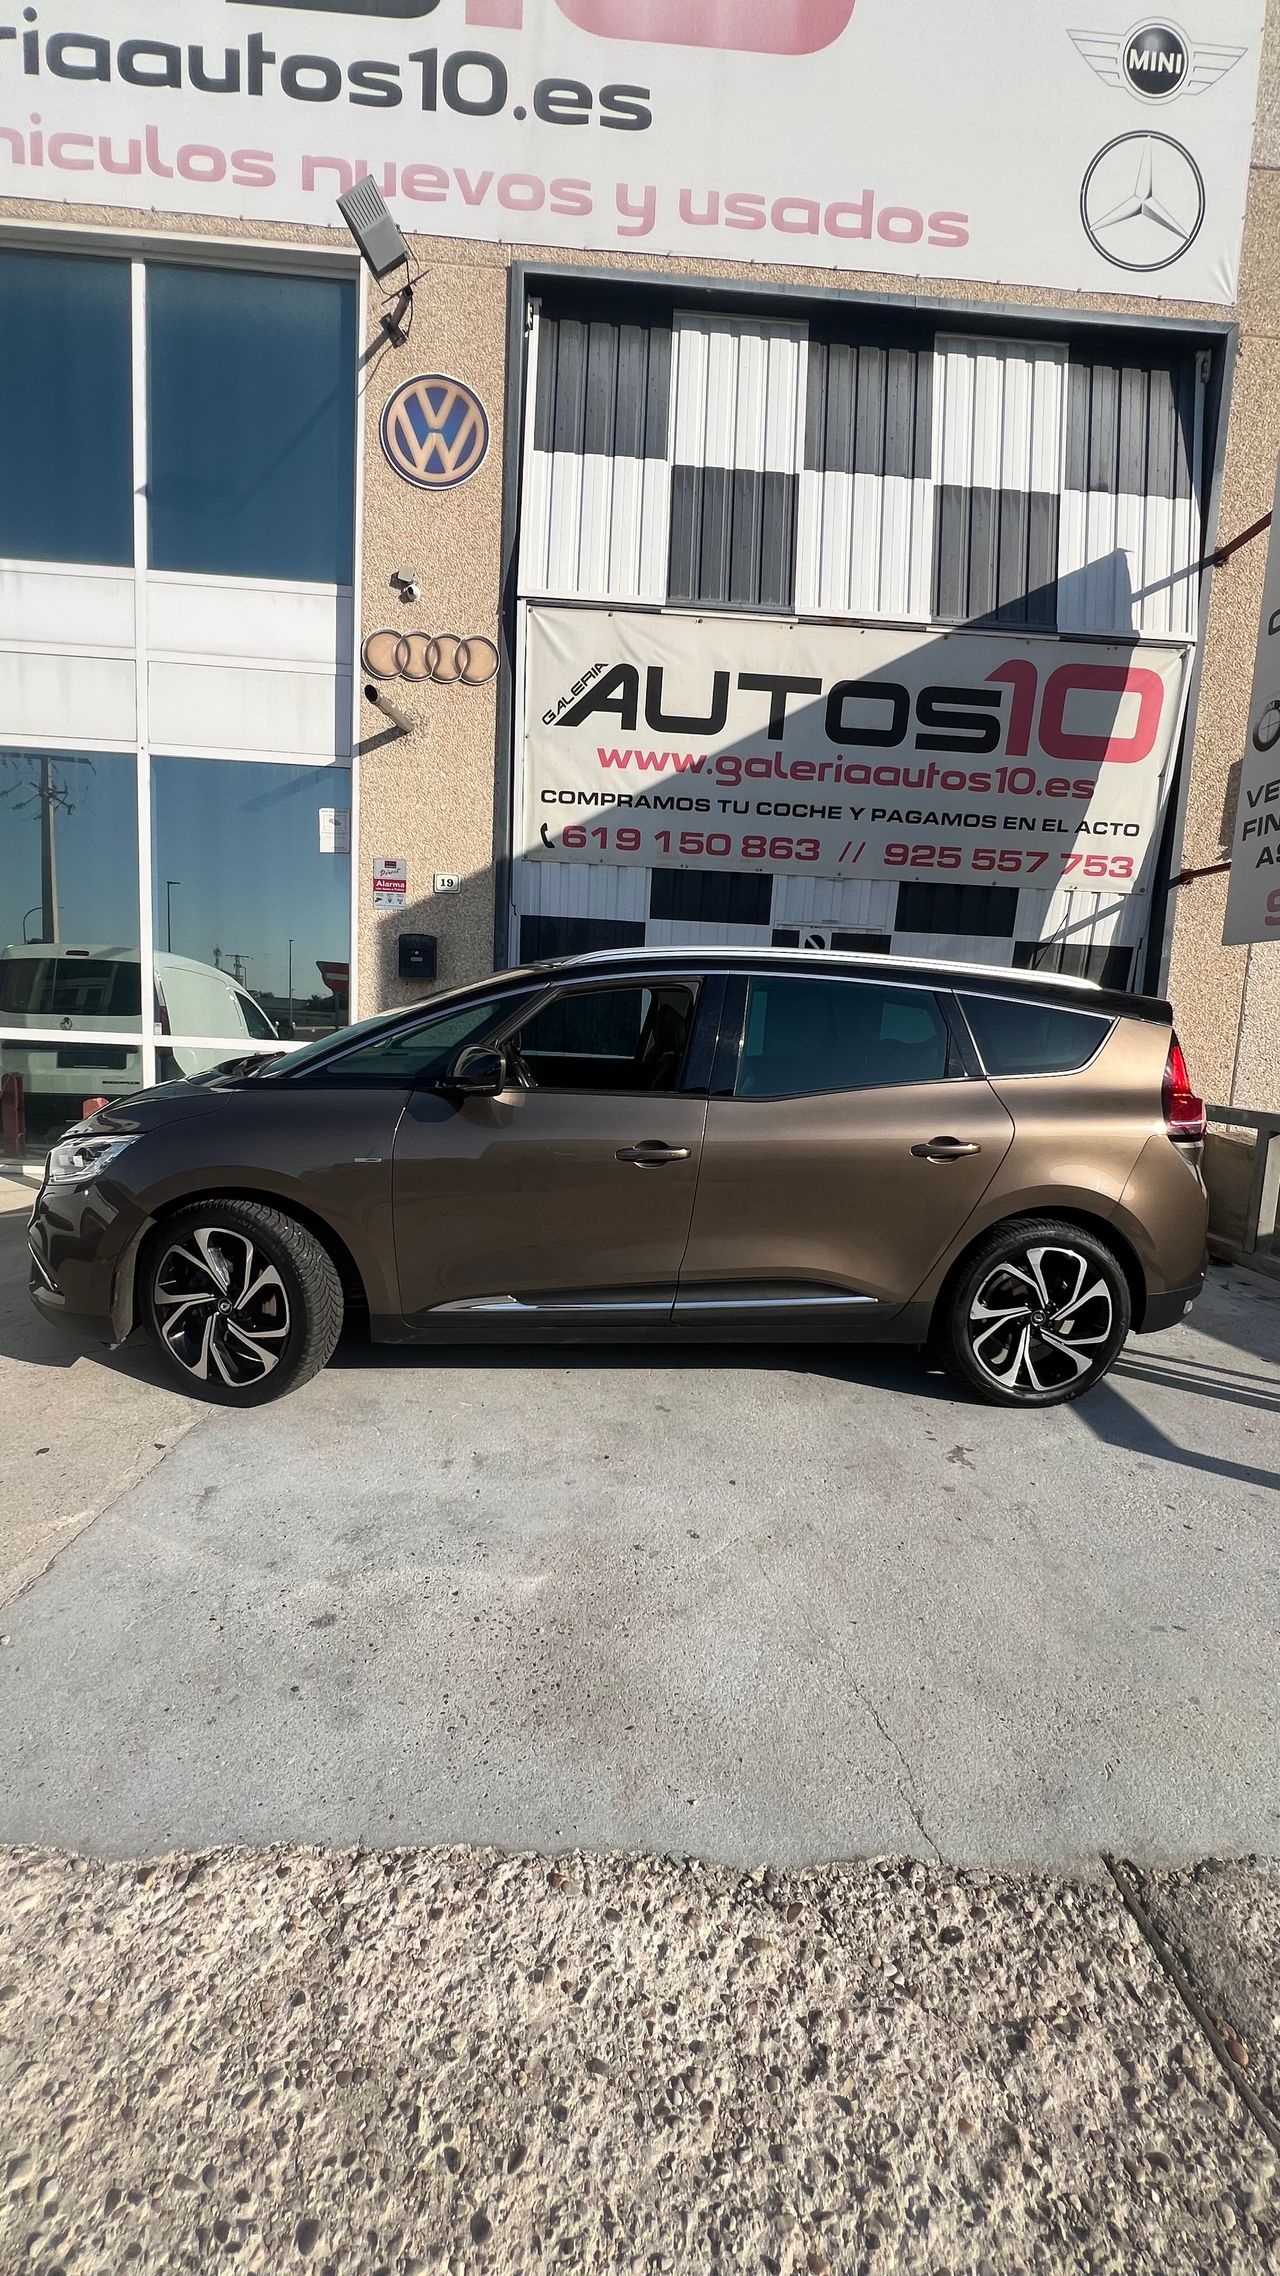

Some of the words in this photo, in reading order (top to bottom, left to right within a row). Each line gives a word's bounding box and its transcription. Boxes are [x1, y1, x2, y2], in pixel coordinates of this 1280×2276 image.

[1129, 48, 1183, 74] MINI
[301, 154, 593, 216] nuevos
[615, 182, 656, 237] y
[678, 188, 970, 248] usados
[541, 662, 609, 726] GALERIA
[554, 658, 1165, 763] AUTOS10
[596, 746, 1096, 799] www.galeriaautos10.es
[540, 789, 711, 812] COMPRAMOS
[717, 799, 750, 815] TU
[755, 801, 843, 820] COCHE
[849, 806, 866, 821] Y
[870, 807, 997, 829] PAGAMOS
[1002, 816, 1036, 832] EN
[1041, 818, 1070, 834] EL
[1073, 820, 1141, 837] ACTO
[562, 825, 642, 851] 619
[654, 830, 732, 857] 150
[740, 835, 821, 862] 863
[883, 843, 962, 869] 925
[970, 849, 1050, 874] 557
[1059, 852, 1134, 879] 753
[376, 880, 405, 888] Alarma
[440, 878, 454, 888] 19
